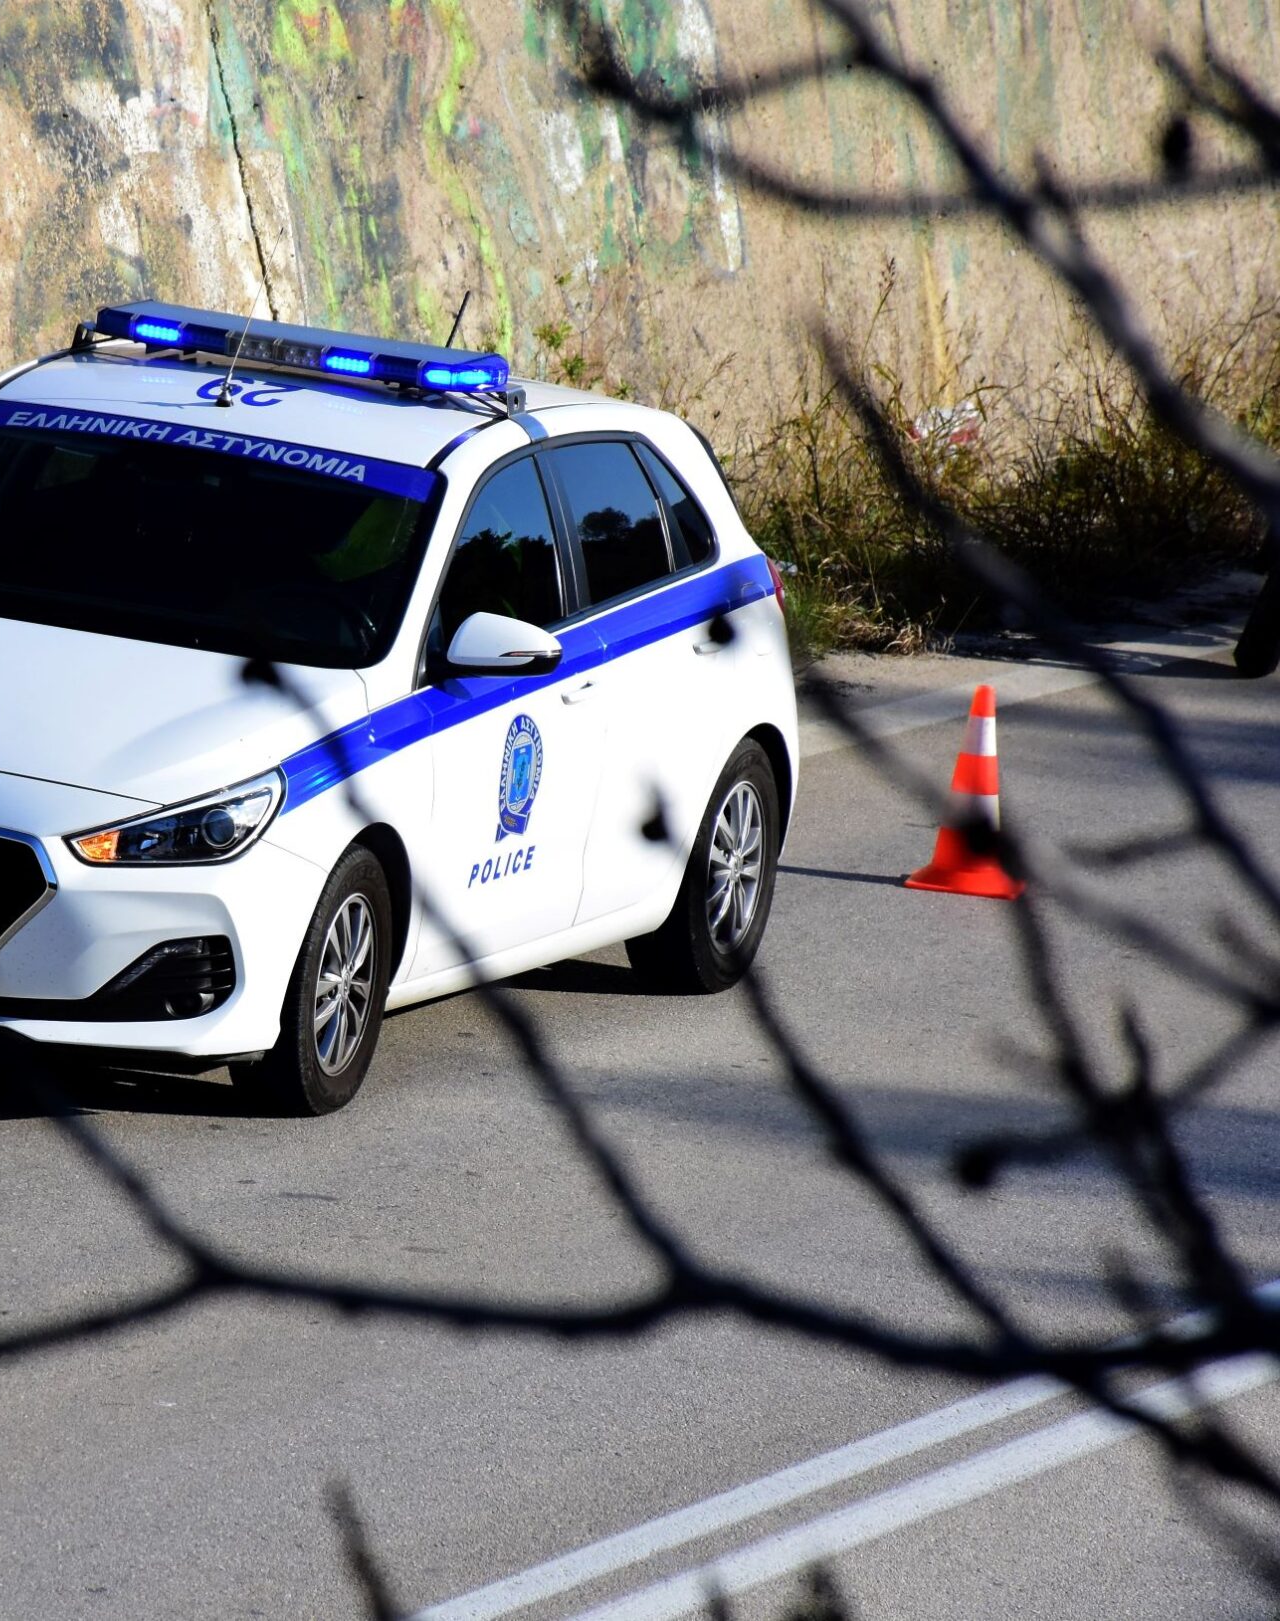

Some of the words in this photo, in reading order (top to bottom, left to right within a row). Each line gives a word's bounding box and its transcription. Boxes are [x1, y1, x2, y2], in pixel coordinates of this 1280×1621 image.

[5, 410, 171, 441] ΕΛΛΗΝΙΚΗ
[173, 428, 368, 483] ΑΣΤΥΝΟΜΙΑ
[500, 721, 519, 812] ΕΛΛΗΝΙΚΗ
[519, 716, 544, 801] ΑΣΤΥΝΟΜΙΑ
[468, 845, 536, 889] POLICE
